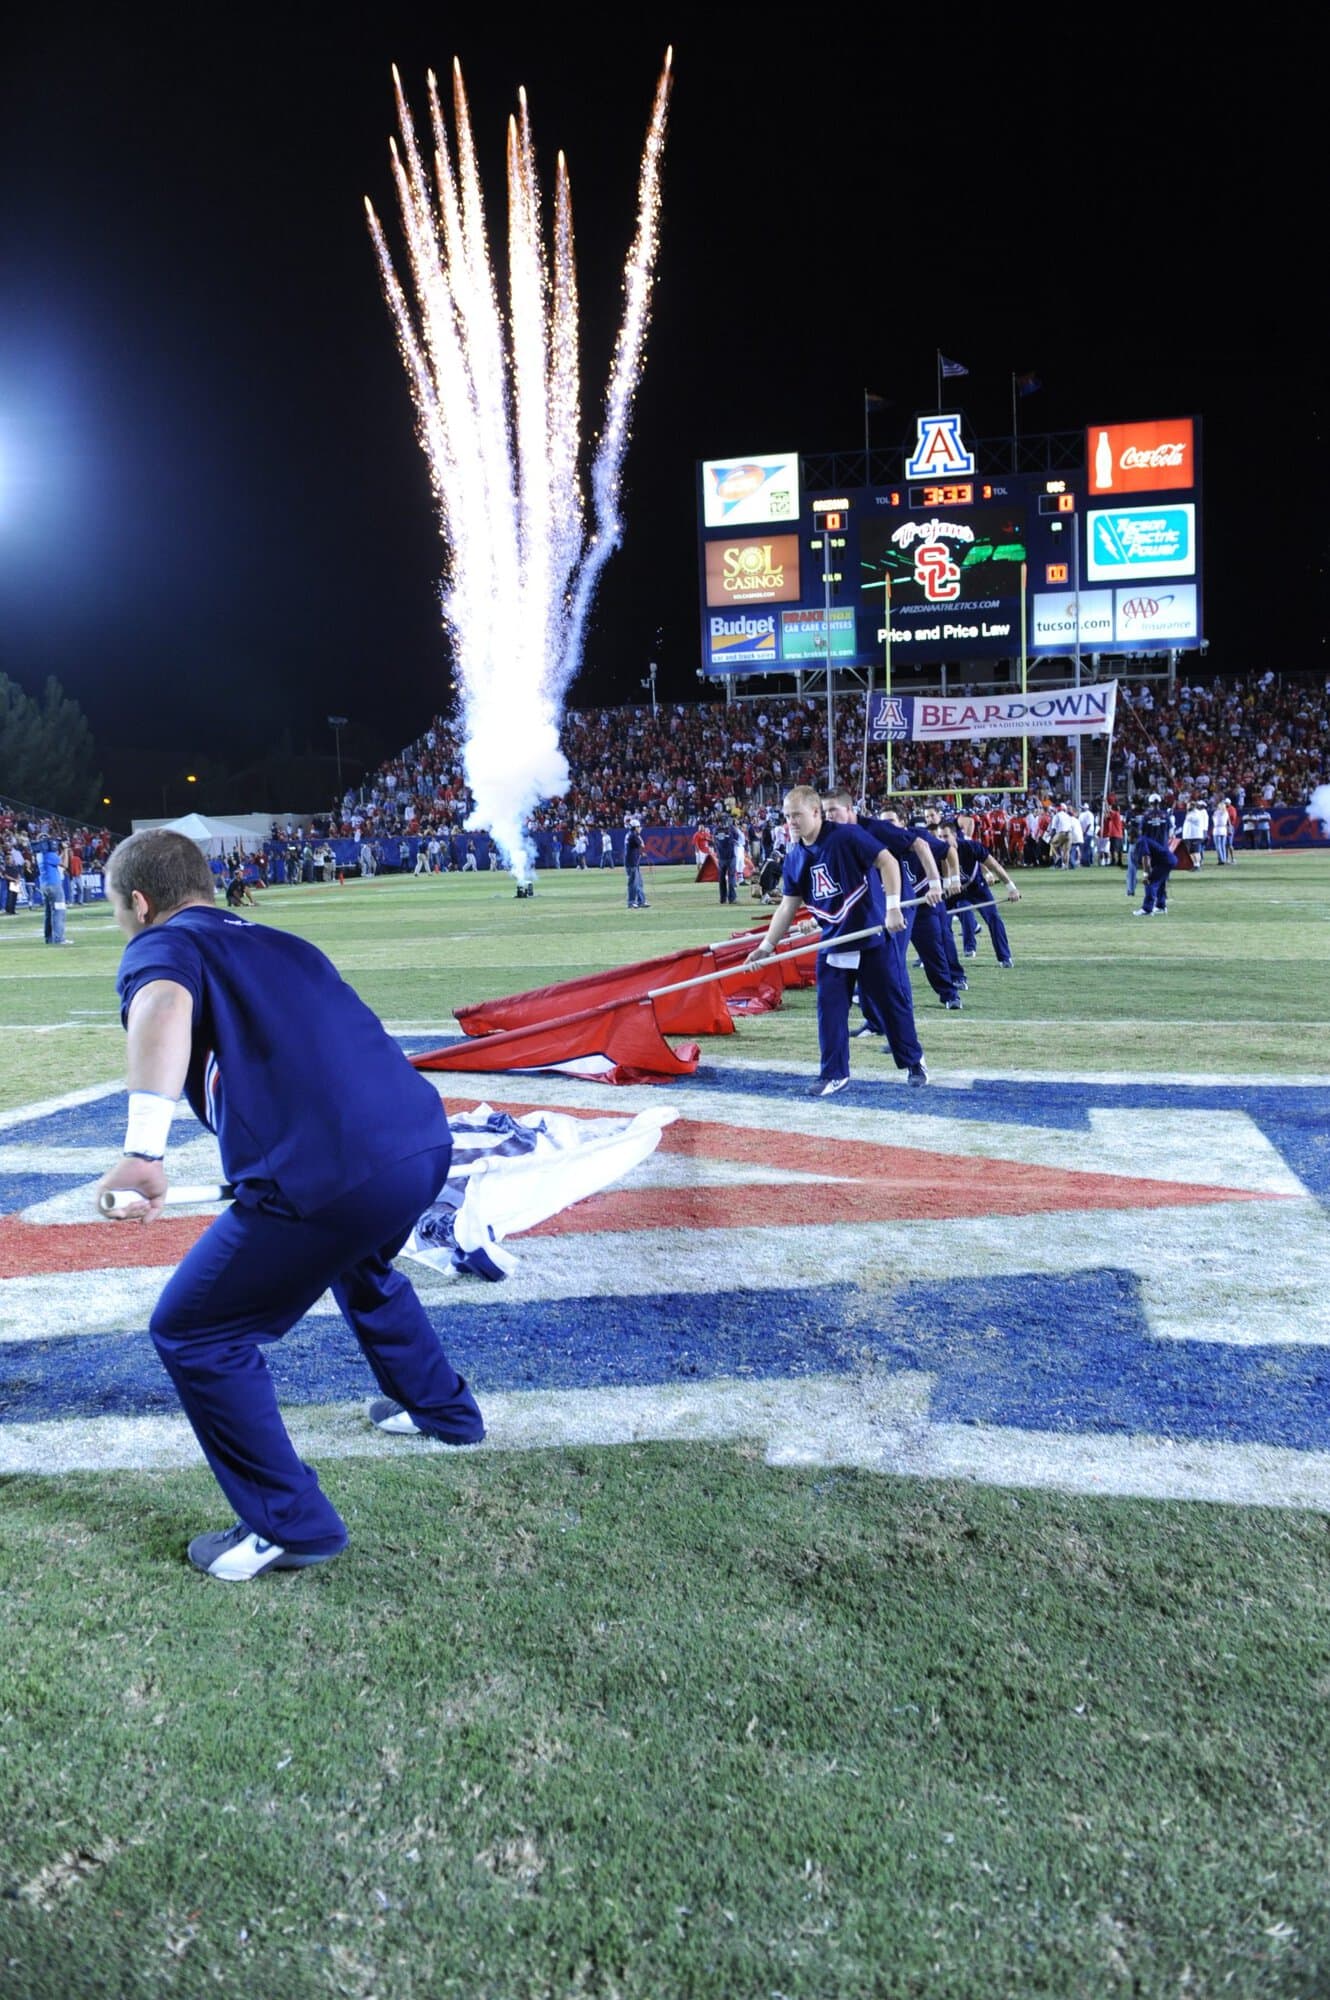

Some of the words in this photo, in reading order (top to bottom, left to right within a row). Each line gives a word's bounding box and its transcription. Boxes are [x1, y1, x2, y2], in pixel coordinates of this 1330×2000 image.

[905, 414, 974, 480] A
[876, 497, 890, 505] TOL
[923, 484, 972, 506] 3:33
[993, 486, 1008, 496] TOL
[723, 545, 783, 577] SOL
[723, 574, 784, 591] CASINOS
[1123, 597, 1160, 619] AAA
[710, 615, 775, 640] Budget
[784, 624, 801, 633] CAR
[823, 621, 853, 632] CNTERS
[878, 627, 912, 643] Price
[915, 626, 940, 640] and
[943, 623, 978, 637] Price
[982, 622, 1010, 637] Law
[874, 697, 907, 730] A
[989, 719, 1030, 729] TRADITION
[1032, 718, 1053, 727] LIVES
[810, 863, 842, 900] A
